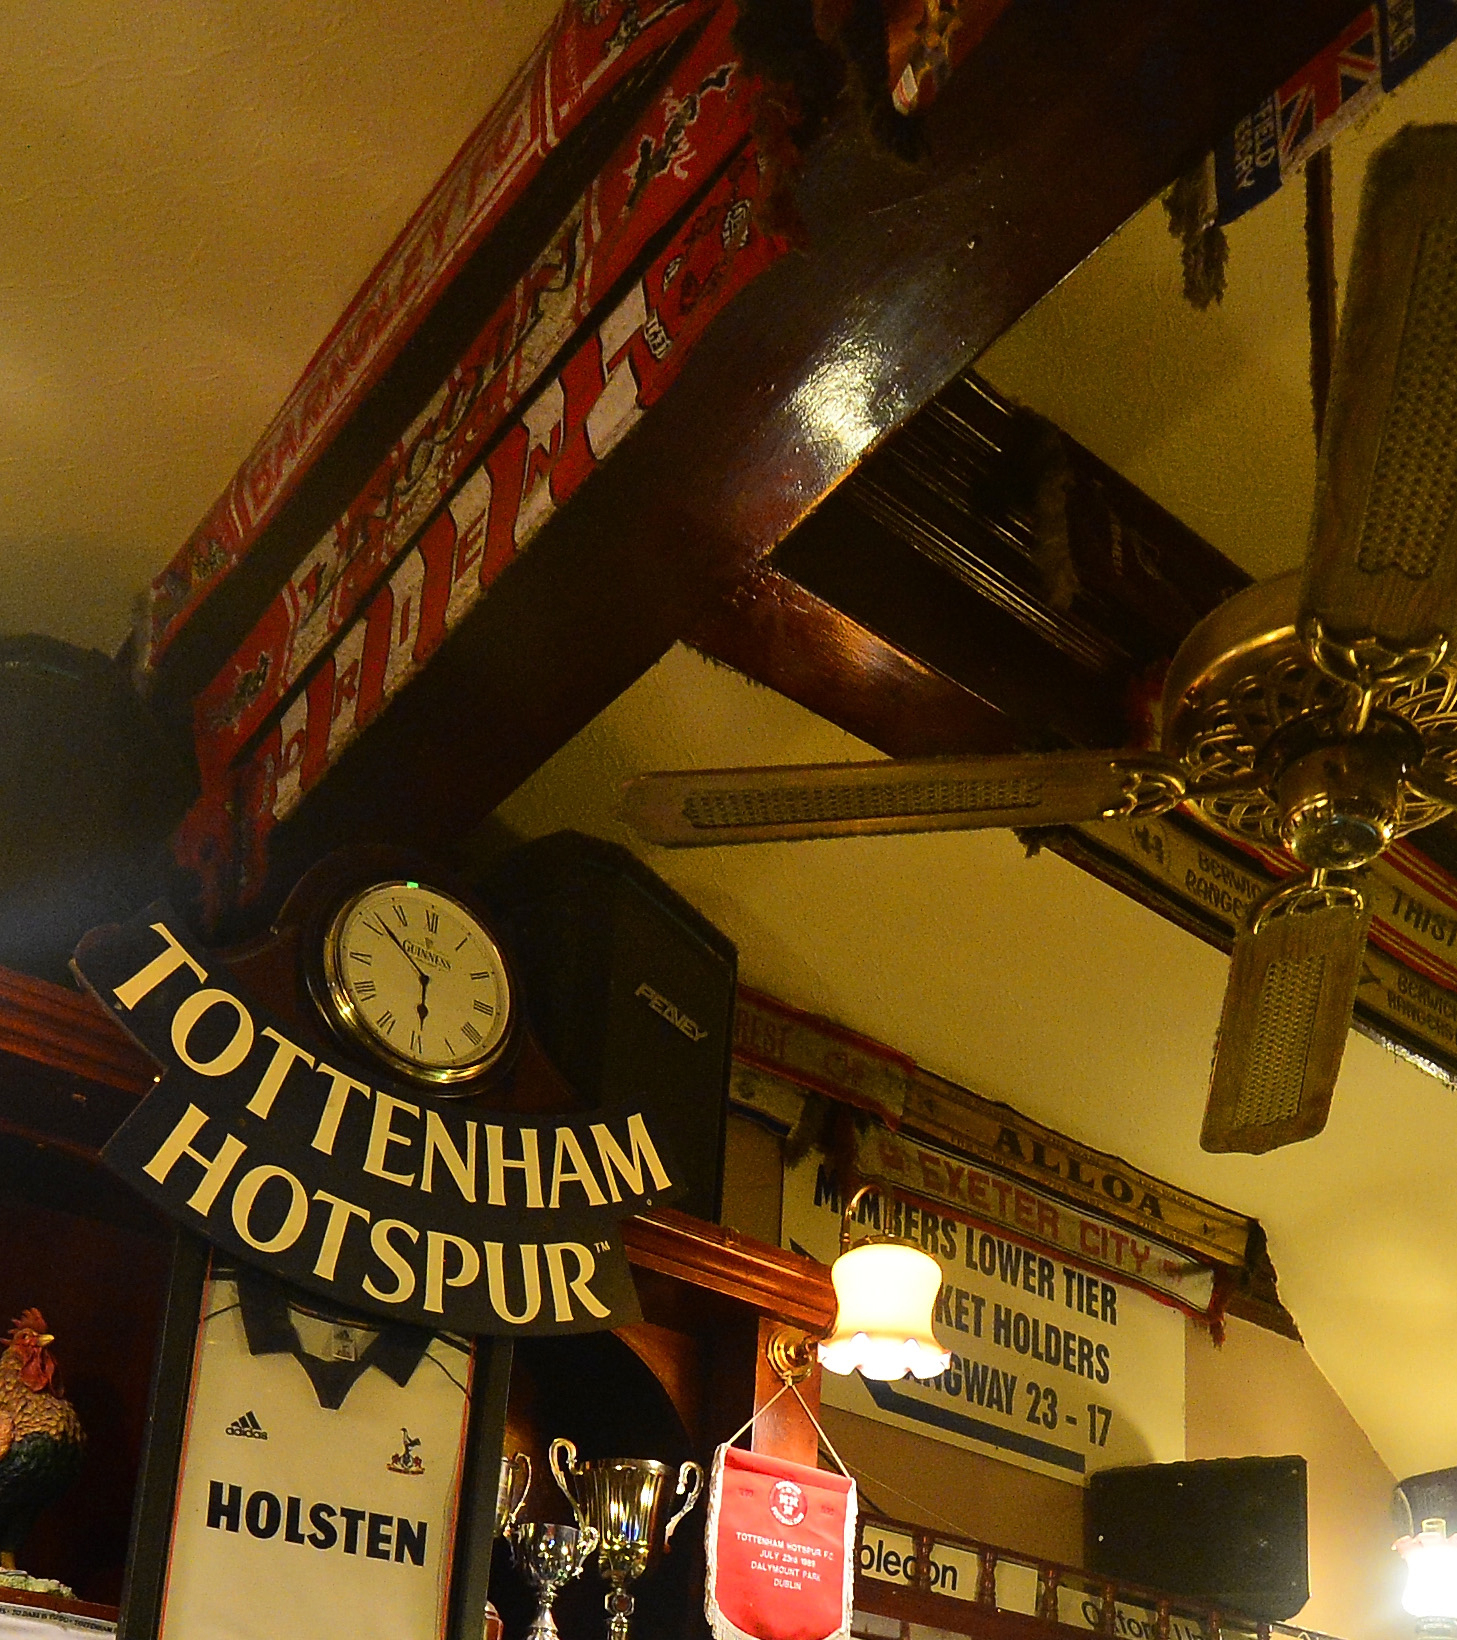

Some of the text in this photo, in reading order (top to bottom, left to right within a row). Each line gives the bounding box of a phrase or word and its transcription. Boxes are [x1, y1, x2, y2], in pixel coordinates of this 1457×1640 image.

[402, 939, 452, 971] GUINNESS
[633, 982, 709, 1043] PEAVEY
[114, 922, 672, 1209] TOTTENHAM
[993, 1123, 1168, 1222] ALLOA
[142, 1102, 612, 1325] HOTSPUR
[917, 1153, 1153, 1271] EXETER CITY
[965, 1227, 1056, 1303] LOWER
[1061, 1268, 1119, 1327] TIER
[992, 1306, 1111, 1385] HOLDERS
[225, 1424, 269, 1441] adidas
[1026, 1382, 1114, 1448] 23 17
[206, 1480, 428, 1567] HOLSTEN
[735, 1531, 822, 1558] TOTTENHAM HOTSPUR
[759, 1549, 780, 1561] JULY
[750, 1560, 821, 1583] DALYMOUNT PARK
[773, 1577, 802, 1591] DUBLIN
